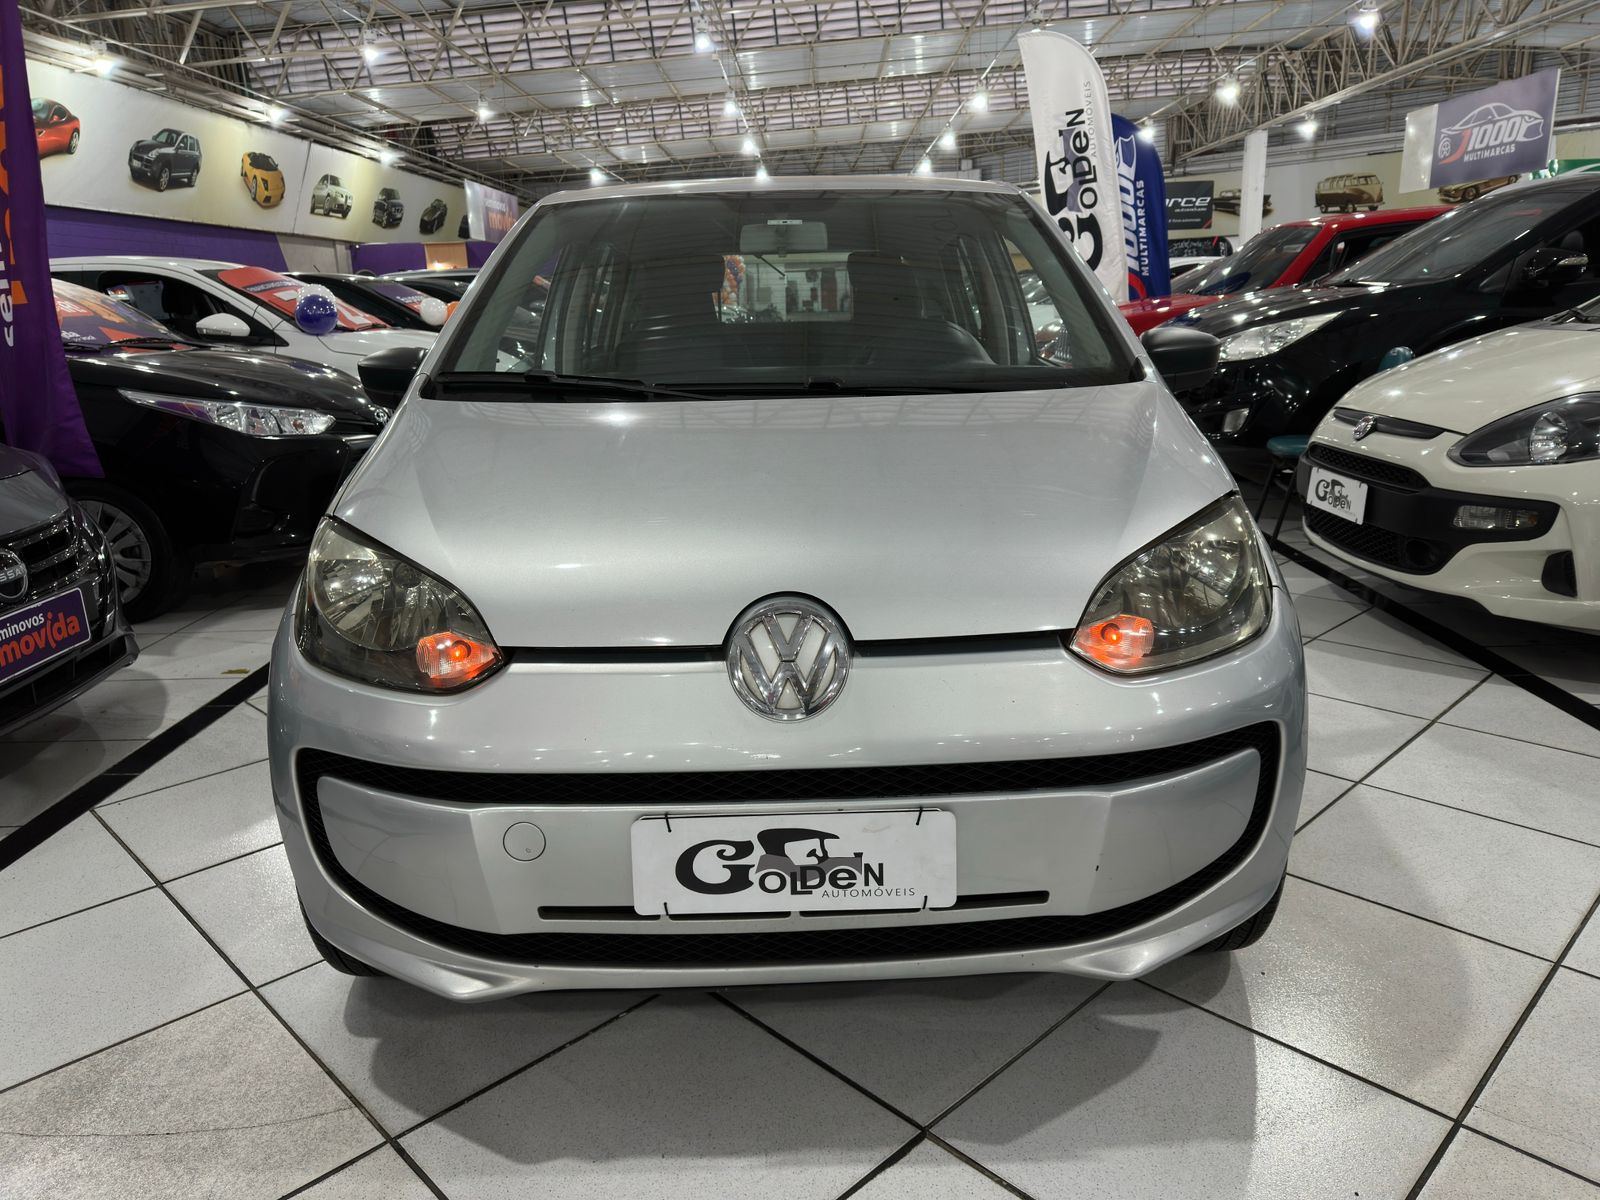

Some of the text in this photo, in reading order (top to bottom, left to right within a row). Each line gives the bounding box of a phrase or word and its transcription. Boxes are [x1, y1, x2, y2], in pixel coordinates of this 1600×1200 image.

[1463, 143, 1516, 162] MULTIMARCAS
[1136, 180, 1150, 276] MULTIMARCAS
[821, 886, 915, 898] AUTOMÓVEIS
